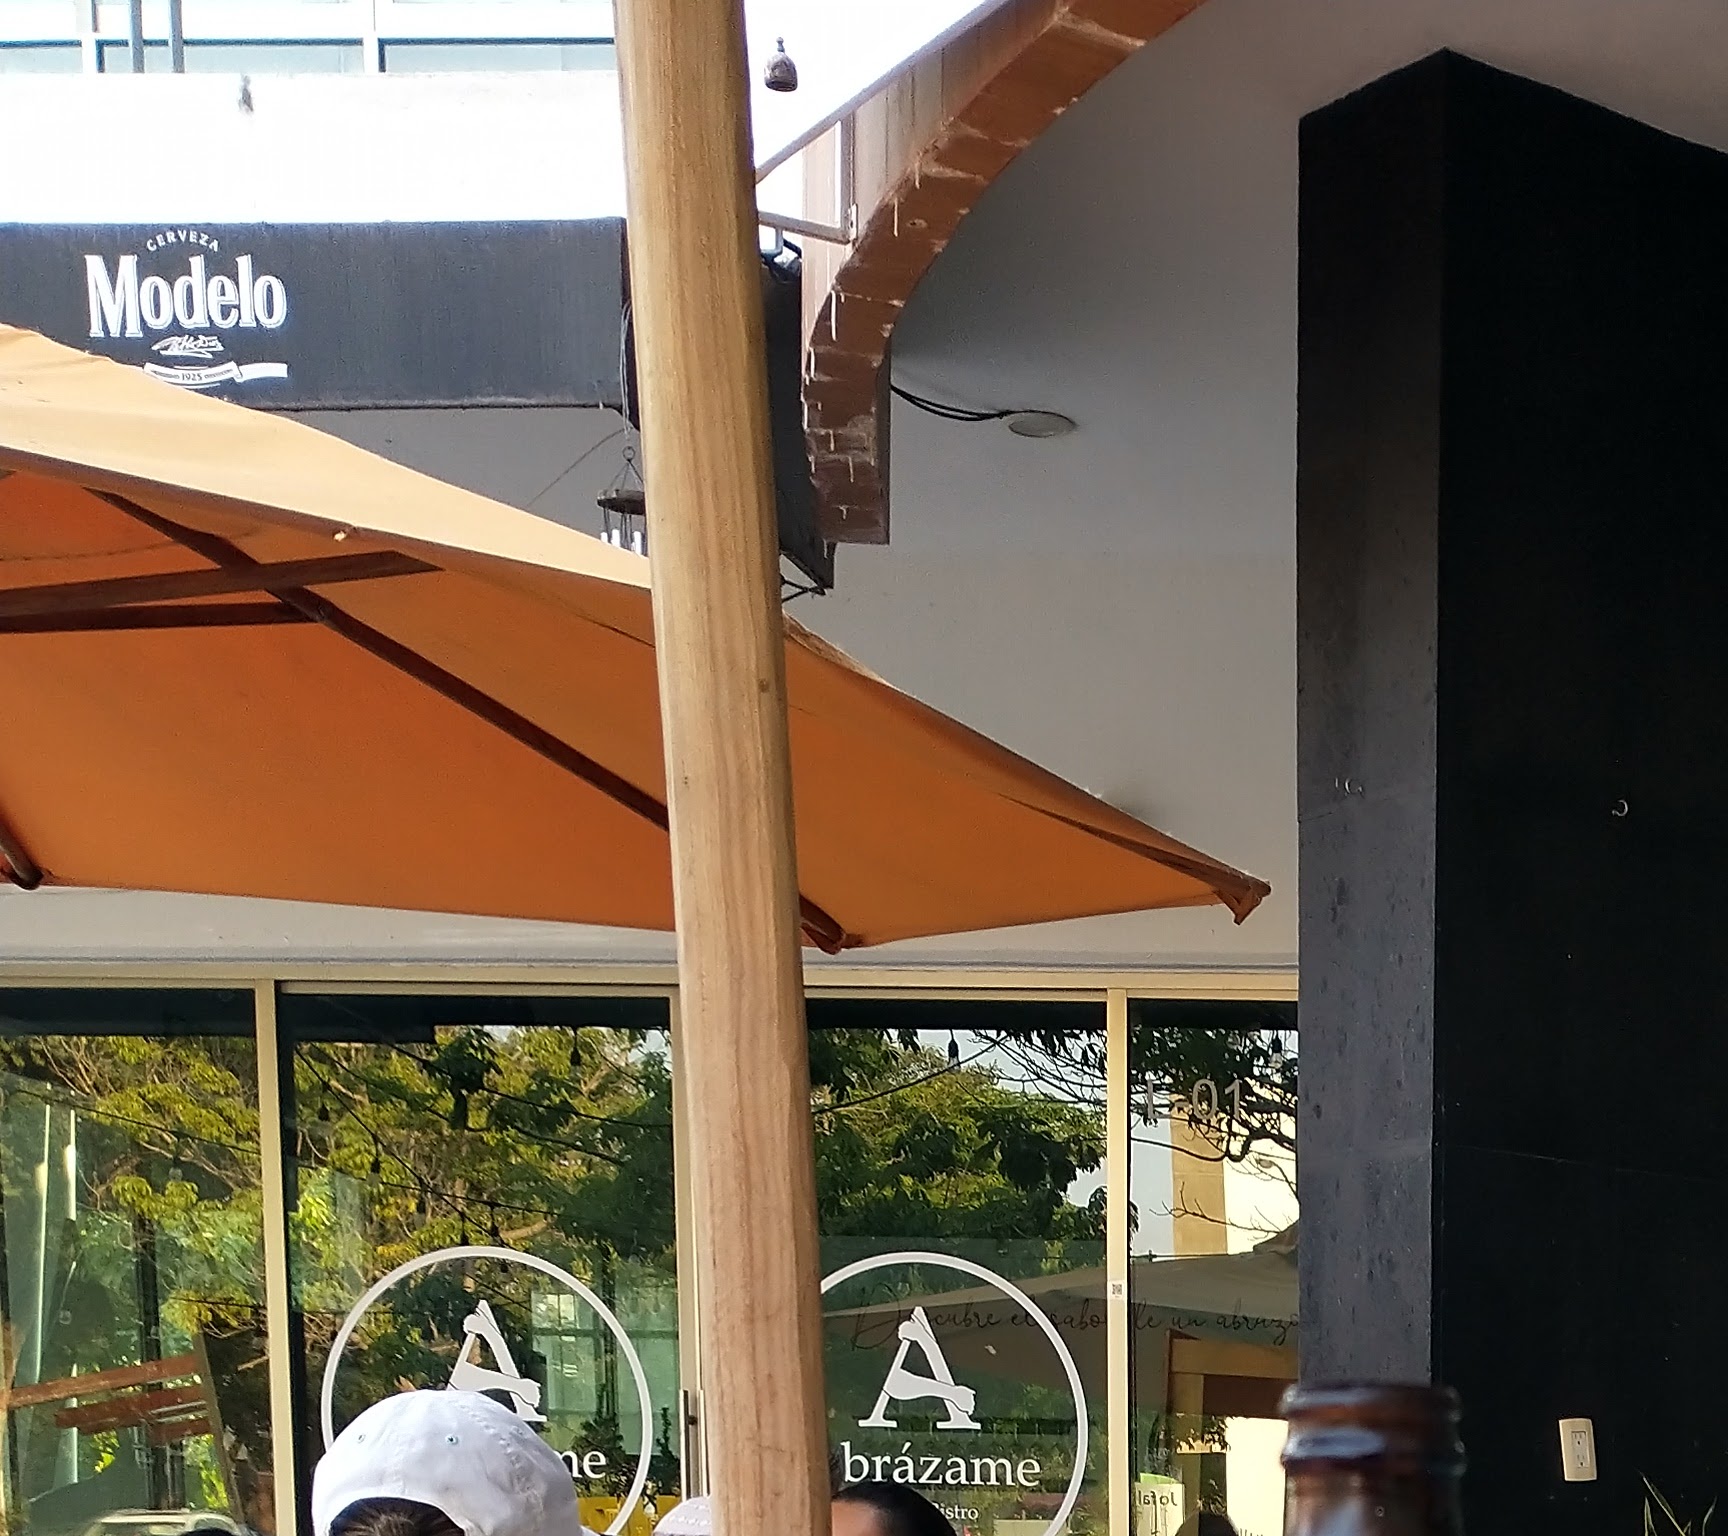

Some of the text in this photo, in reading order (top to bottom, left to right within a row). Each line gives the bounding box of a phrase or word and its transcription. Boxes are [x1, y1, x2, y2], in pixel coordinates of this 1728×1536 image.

[146, 229, 219, 252] CERVEZA
[85, 253, 287, 338] Modelo
[180, 372, 202, 381] 1925
[1147, 1078, 1243, 1120] L-01
[840, 1441, 1041, 1487] brázame
[931, 1502, 979, 1520] istro
